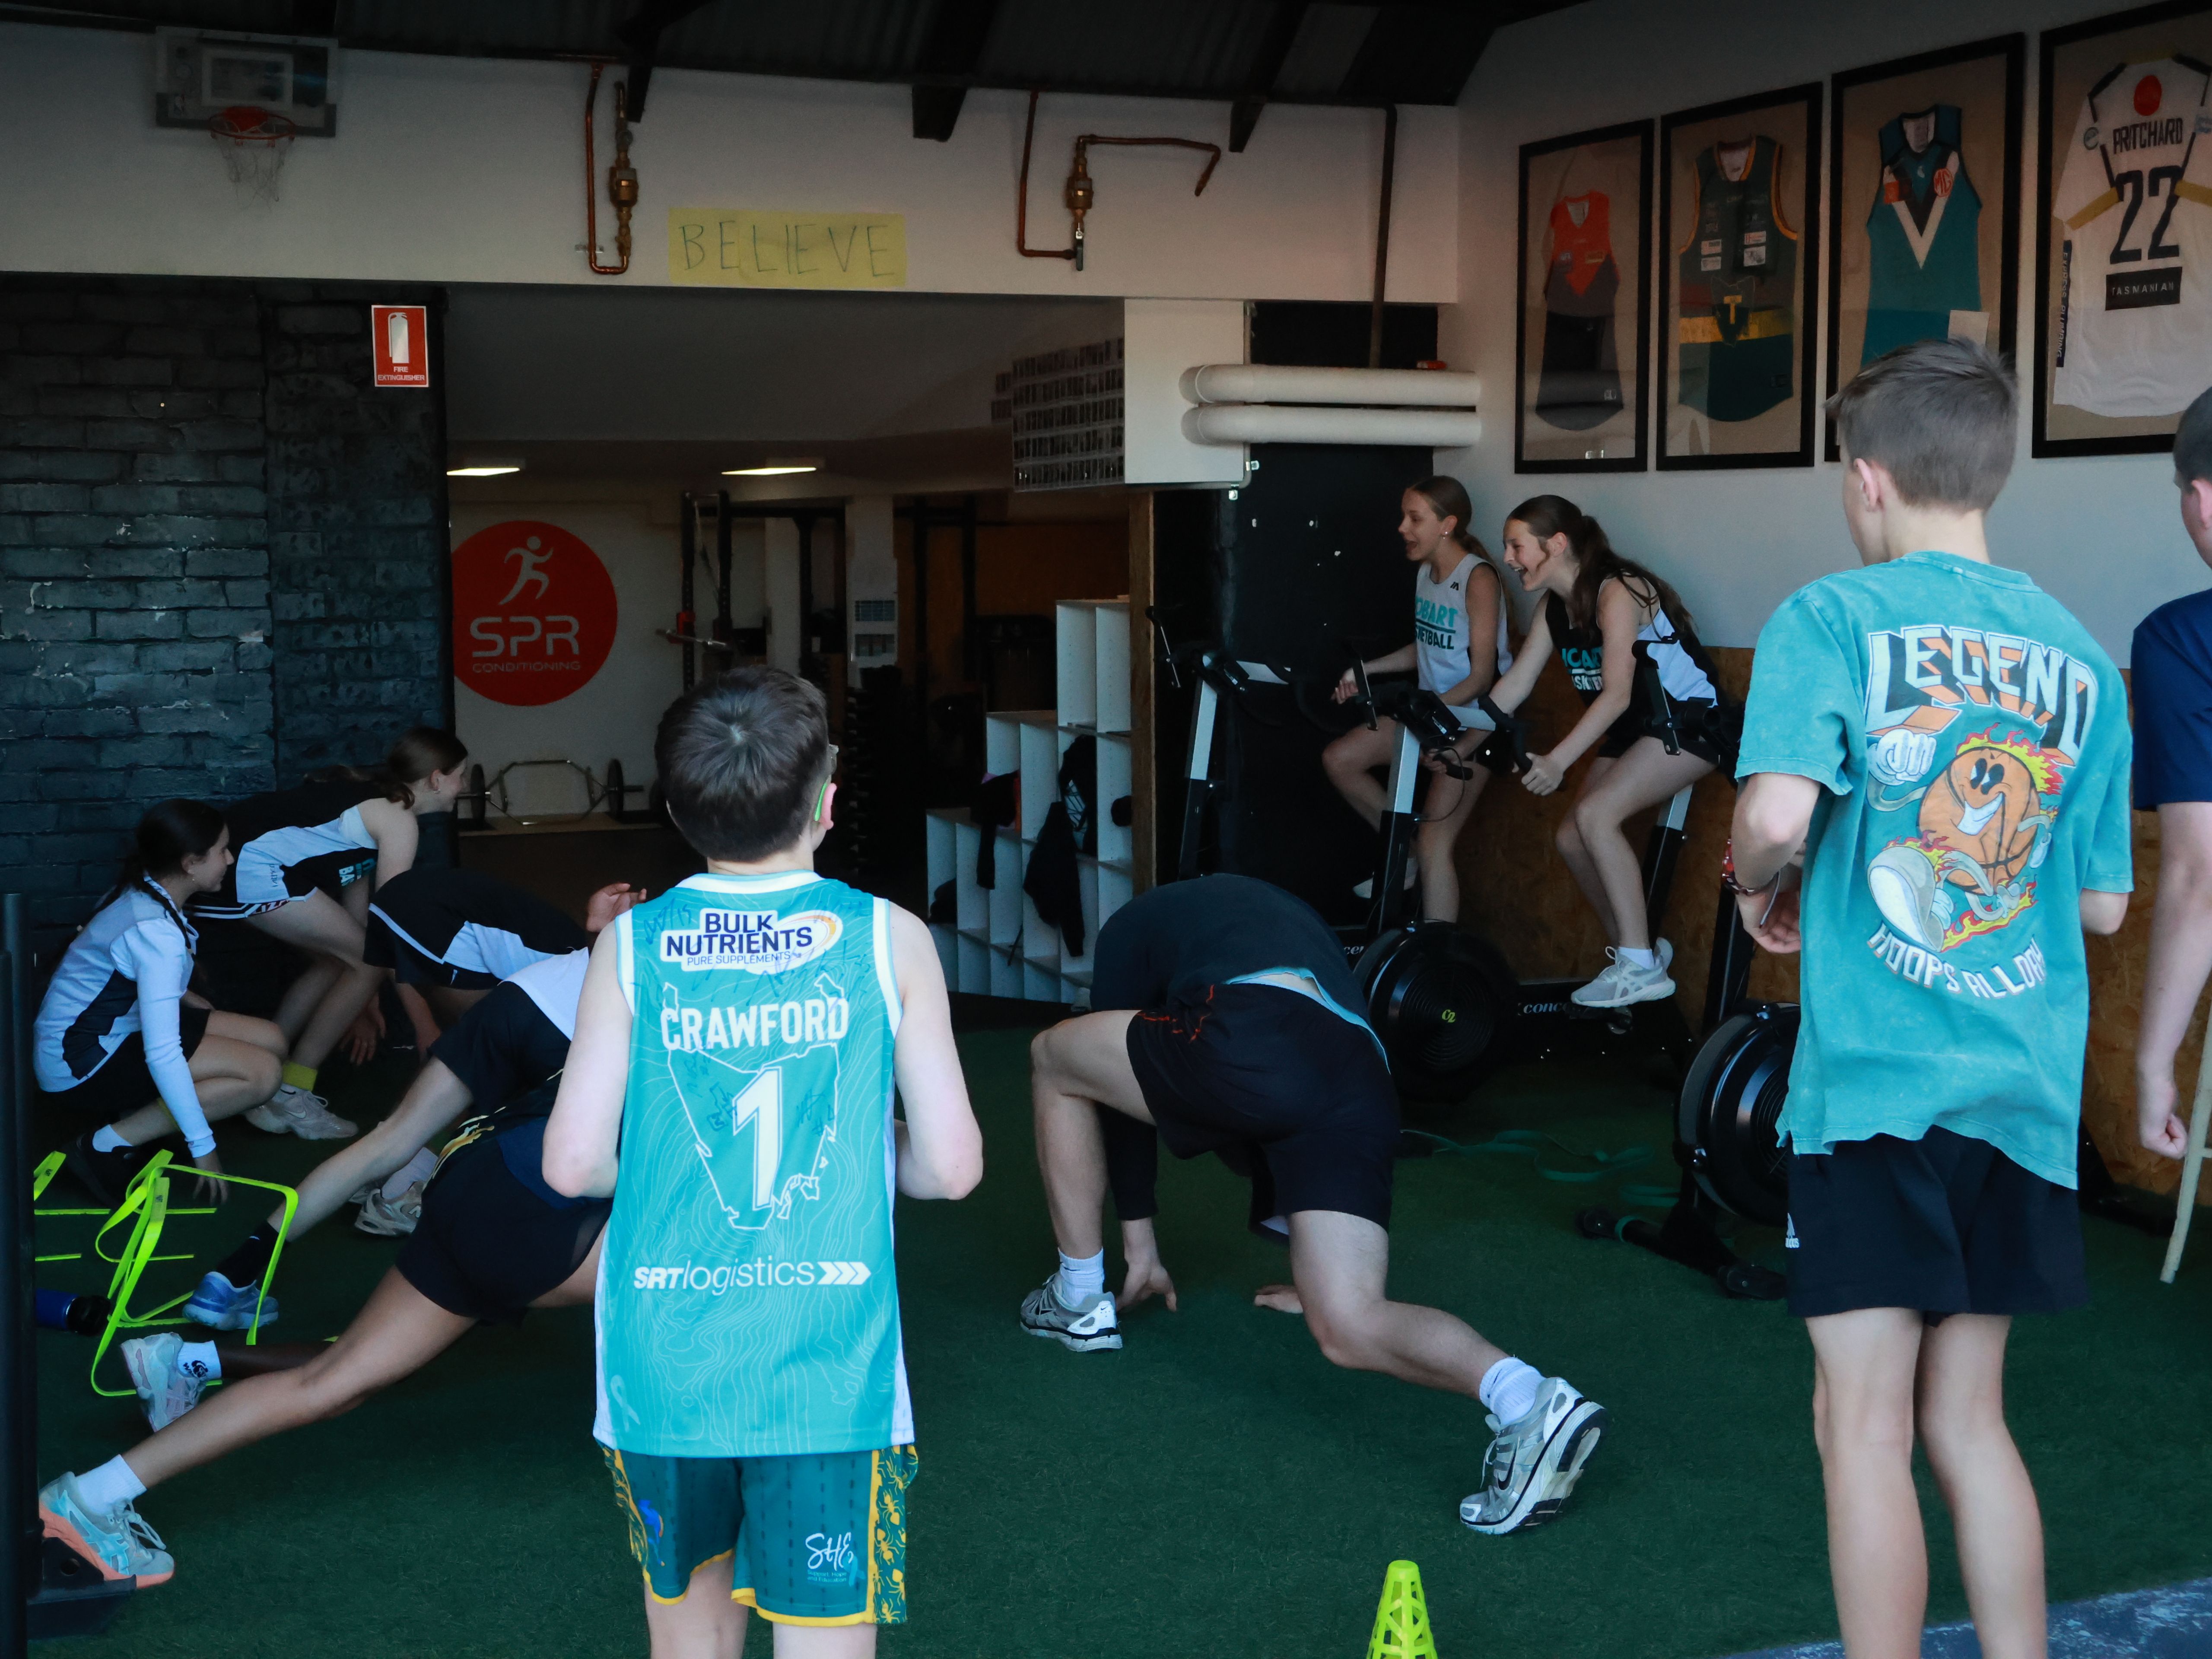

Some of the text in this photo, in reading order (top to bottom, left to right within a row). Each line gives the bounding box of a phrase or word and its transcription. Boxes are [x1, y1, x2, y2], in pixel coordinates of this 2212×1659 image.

[2113, 118, 2183, 154] PRITCHARD
[2110, 165, 2182, 264] 22
[679, 221, 894, 276] BELIEVE
[2111, 281, 2174, 296] TASMANIAN
[1415, 595, 1458, 627] OBART
[470, 615, 580, 658] SPR
[472, 661, 581, 673] CONDITIONING
[1865, 625, 2098, 766] LEGEND
[705, 913, 773, 933] BULK
[667, 927, 813, 957] NUTRIENTS
[687, 951, 791, 966] PURE SUPPLEMENTS
[1867, 920, 1963, 994] HOOPS
[1960, 964, 2026, 998] ALL
[661, 998, 849, 1050] CRAWFORD
[732, 1066, 782, 1210] 1
